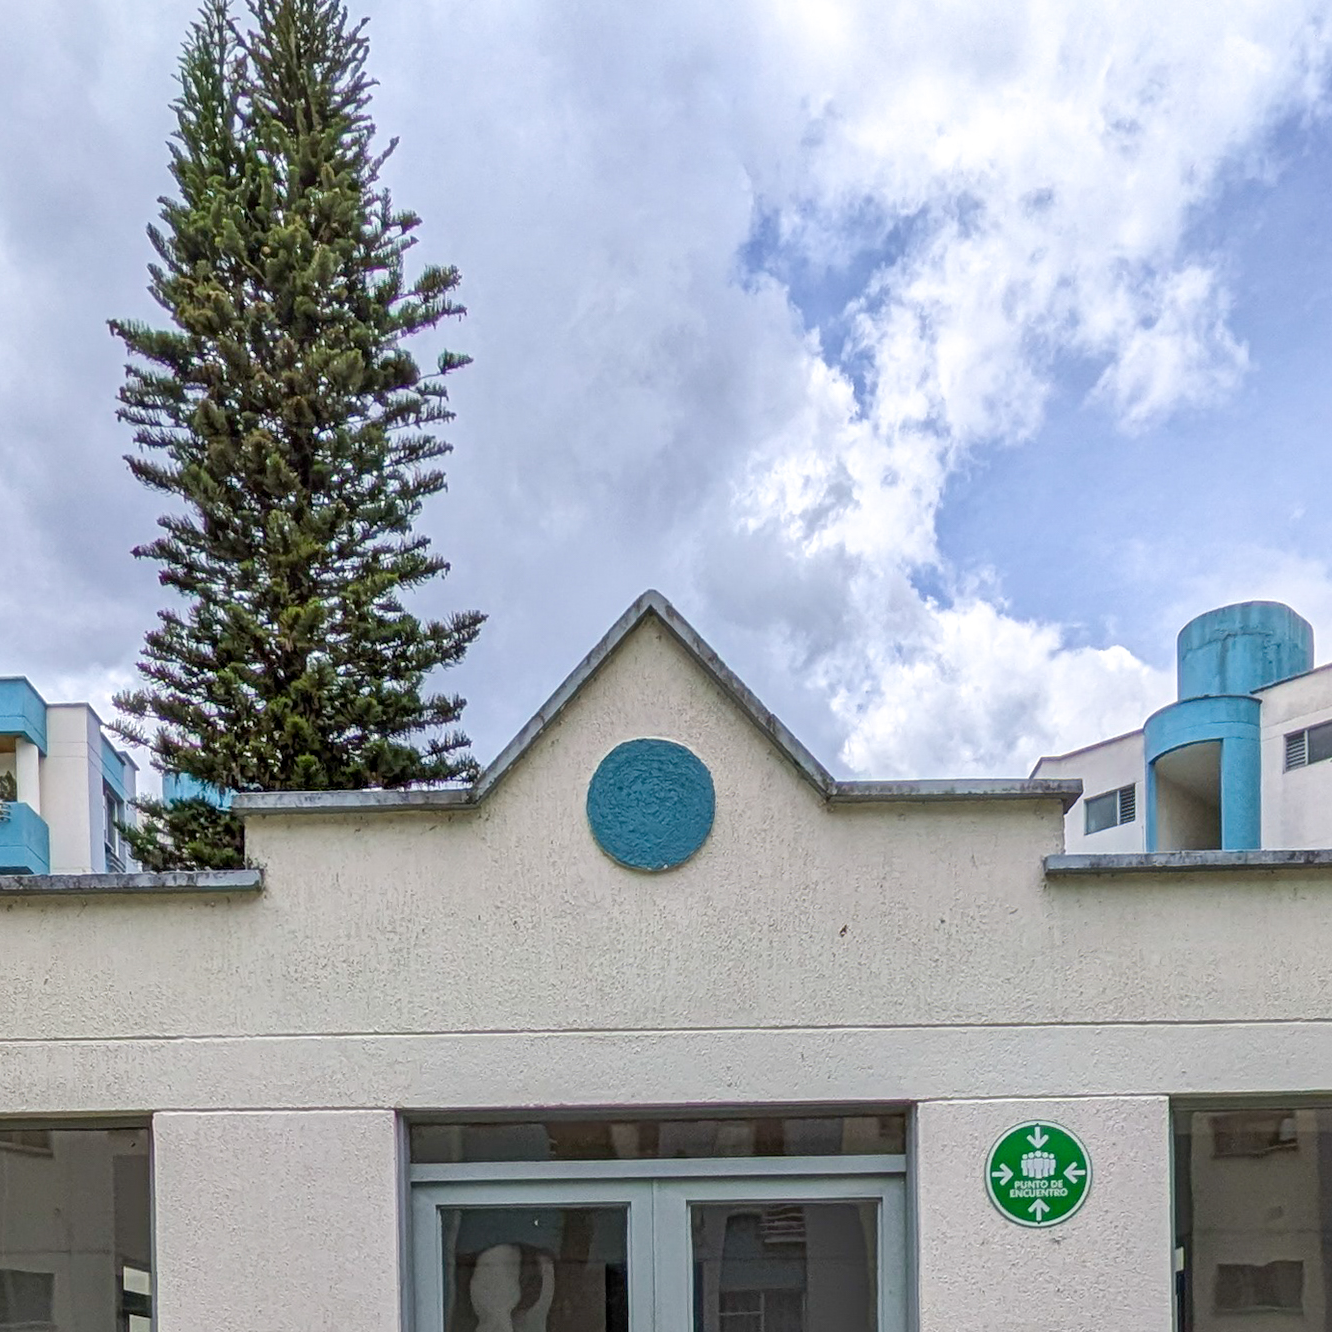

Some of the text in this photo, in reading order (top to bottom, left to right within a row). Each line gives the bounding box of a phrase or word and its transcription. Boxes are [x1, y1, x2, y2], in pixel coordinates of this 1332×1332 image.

[1014, 1180, 1064, 1189] PUNTO DE
[1009, 1188, 1068, 1198] ENCUENTRO
